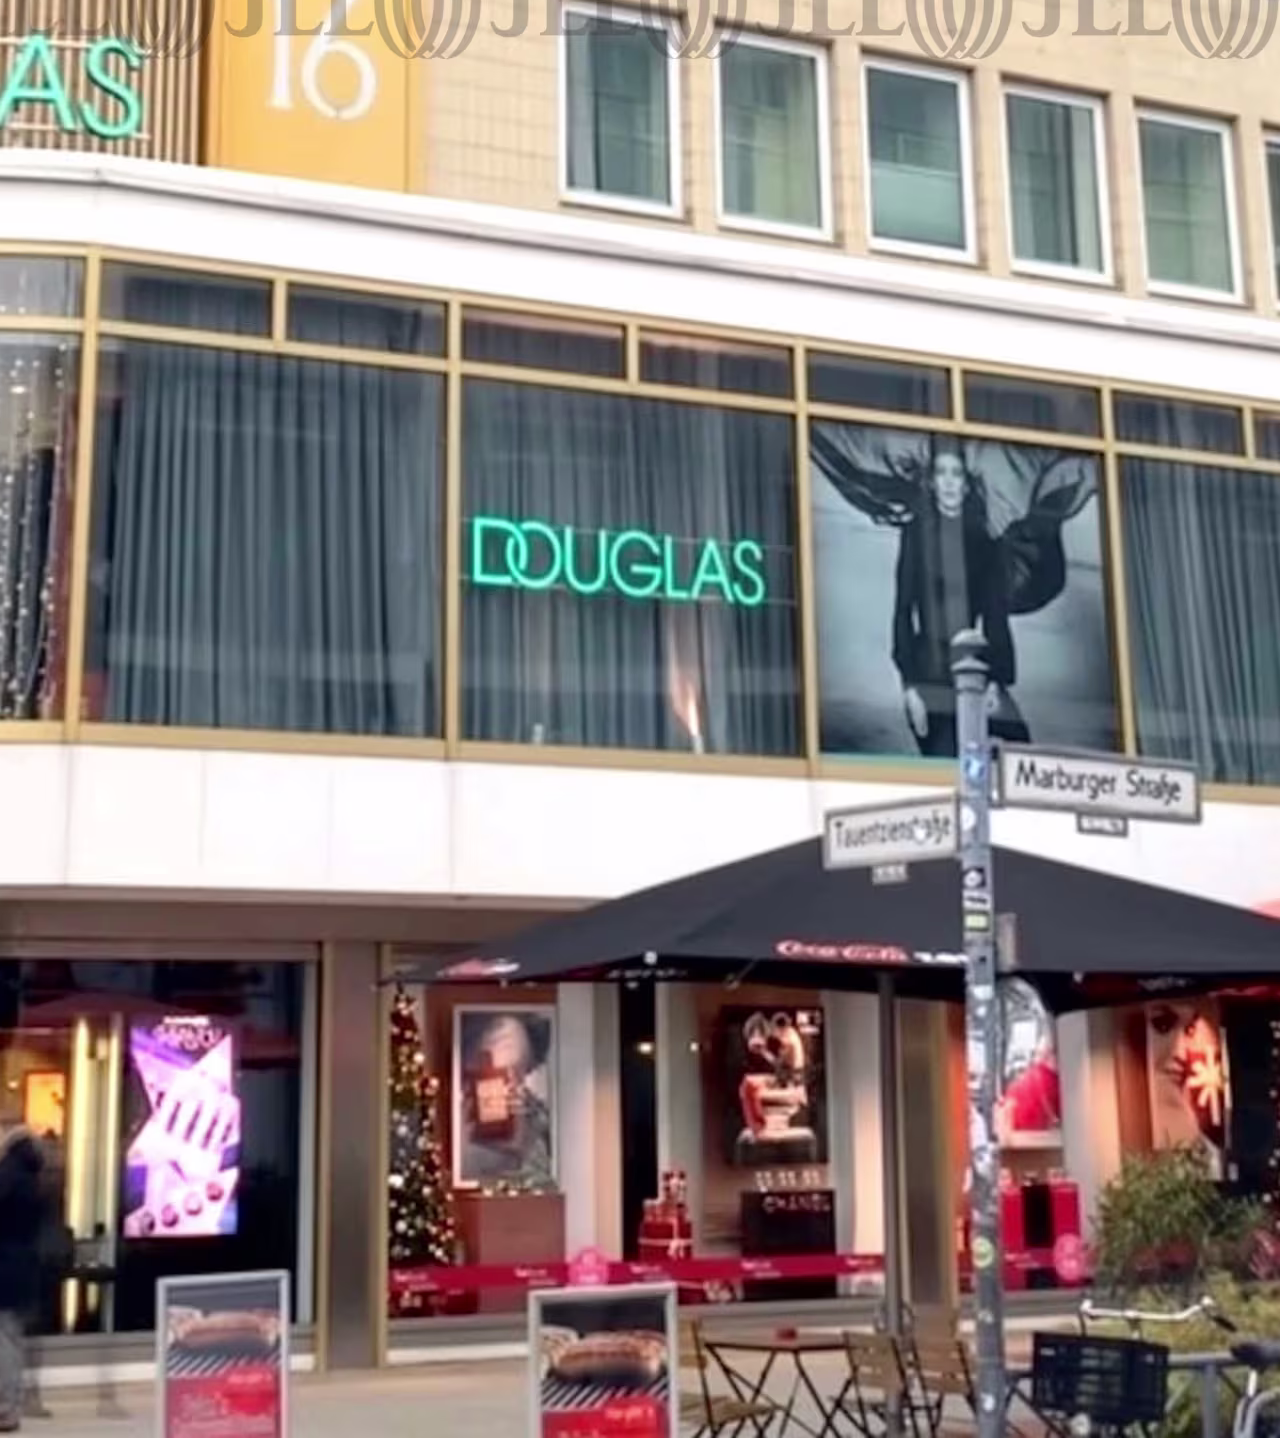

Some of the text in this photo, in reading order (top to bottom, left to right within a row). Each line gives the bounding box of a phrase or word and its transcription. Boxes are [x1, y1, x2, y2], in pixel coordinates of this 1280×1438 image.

[471, 516, 766, 607] DOUGLAS
[1014, 759, 1182, 807] Marburger Straße
